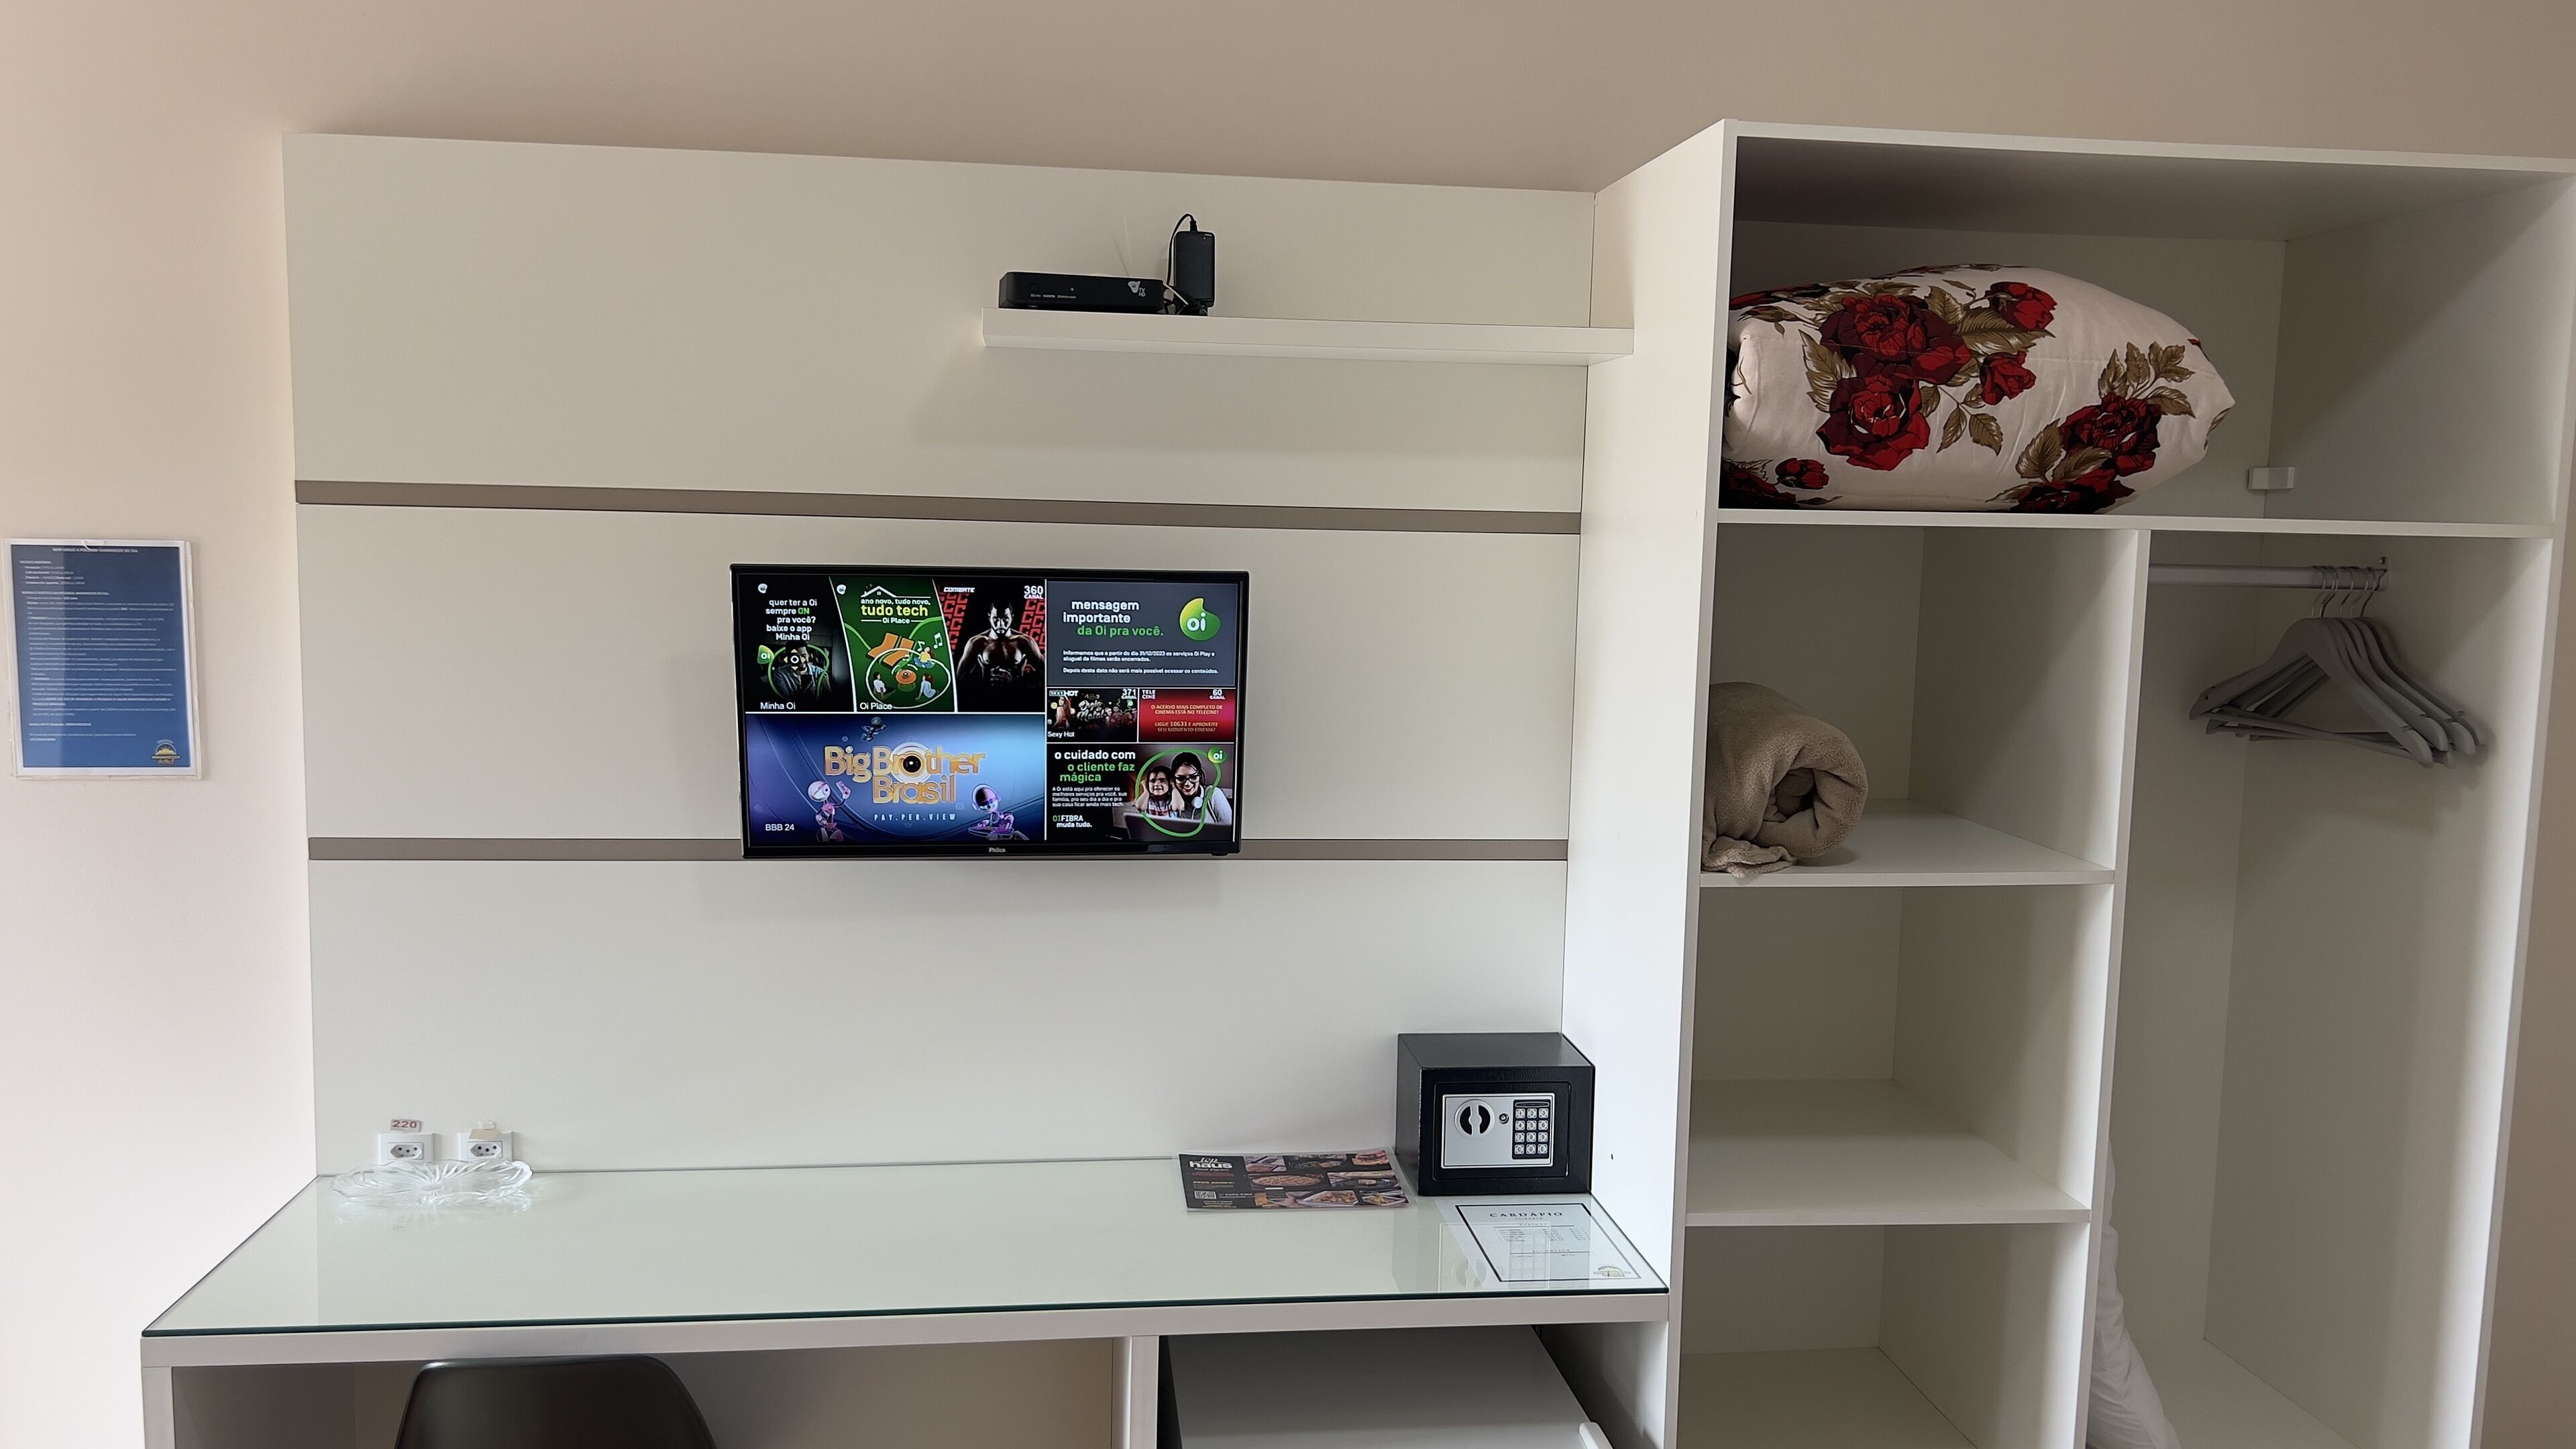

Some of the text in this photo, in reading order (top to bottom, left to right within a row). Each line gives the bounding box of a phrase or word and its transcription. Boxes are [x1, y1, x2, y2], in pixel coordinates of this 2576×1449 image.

[1024, 586, 1043, 594] 360
[861, 604, 928, 616] tudo tech
[1071, 601, 1139, 612] mensagem
[1063, 612, 1131, 625] importante
[1187, 612, 1206, 632] oi
[1077, 625, 1164, 637] da Oi pra você.
[1064, 750, 1108, 759] cuidado
[1112, 751, 1136, 759] com
[824, 745, 986, 783] Big Brother
[1077, 762, 1115, 771] cliente
[1118, 762, 1135, 771] faz
[1060, 772, 1101, 783] mágica
[872, 775, 956, 804] Brasil
[393, 1120, 417, 1128] 220
